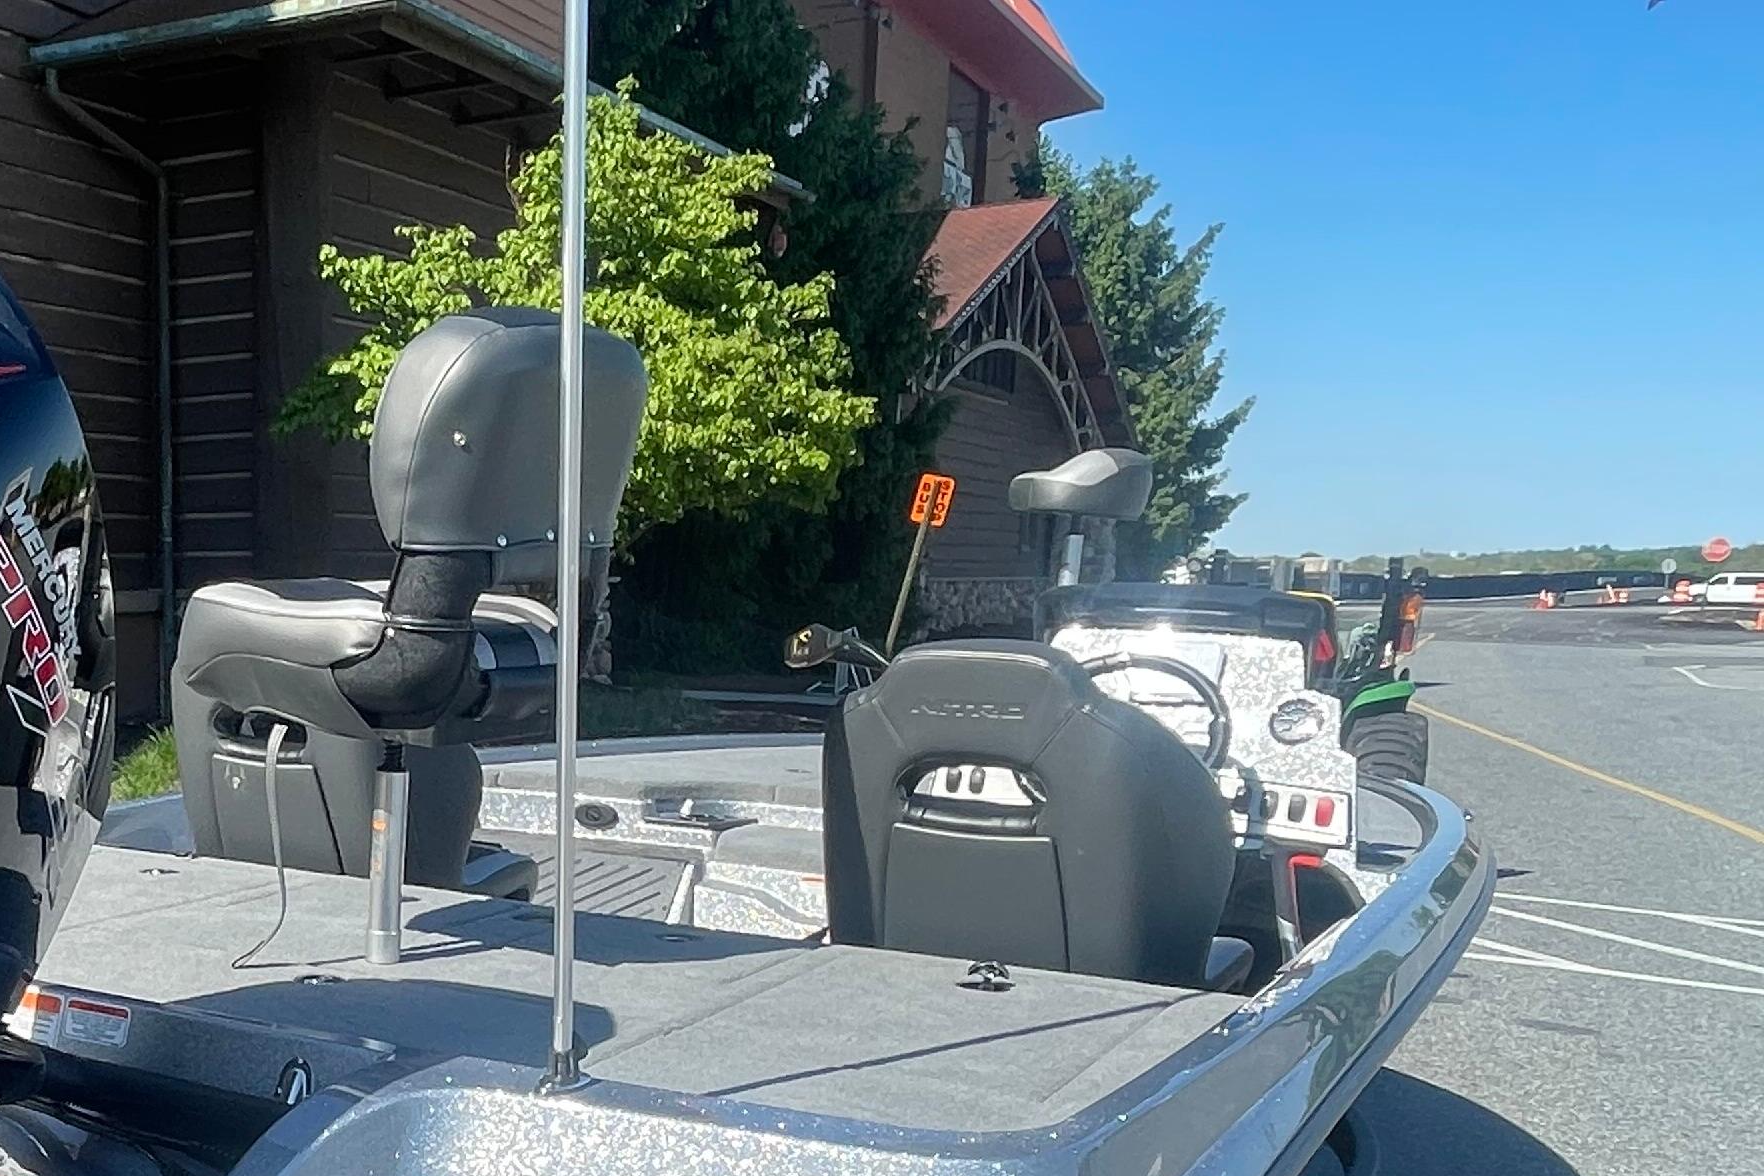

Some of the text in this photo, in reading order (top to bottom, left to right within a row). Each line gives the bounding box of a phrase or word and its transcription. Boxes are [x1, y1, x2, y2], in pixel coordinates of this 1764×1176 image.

[916, 482, 931, 514] BUS
[930, 480, 951, 522] STOP
[5, 497, 82, 656] MERCURY
